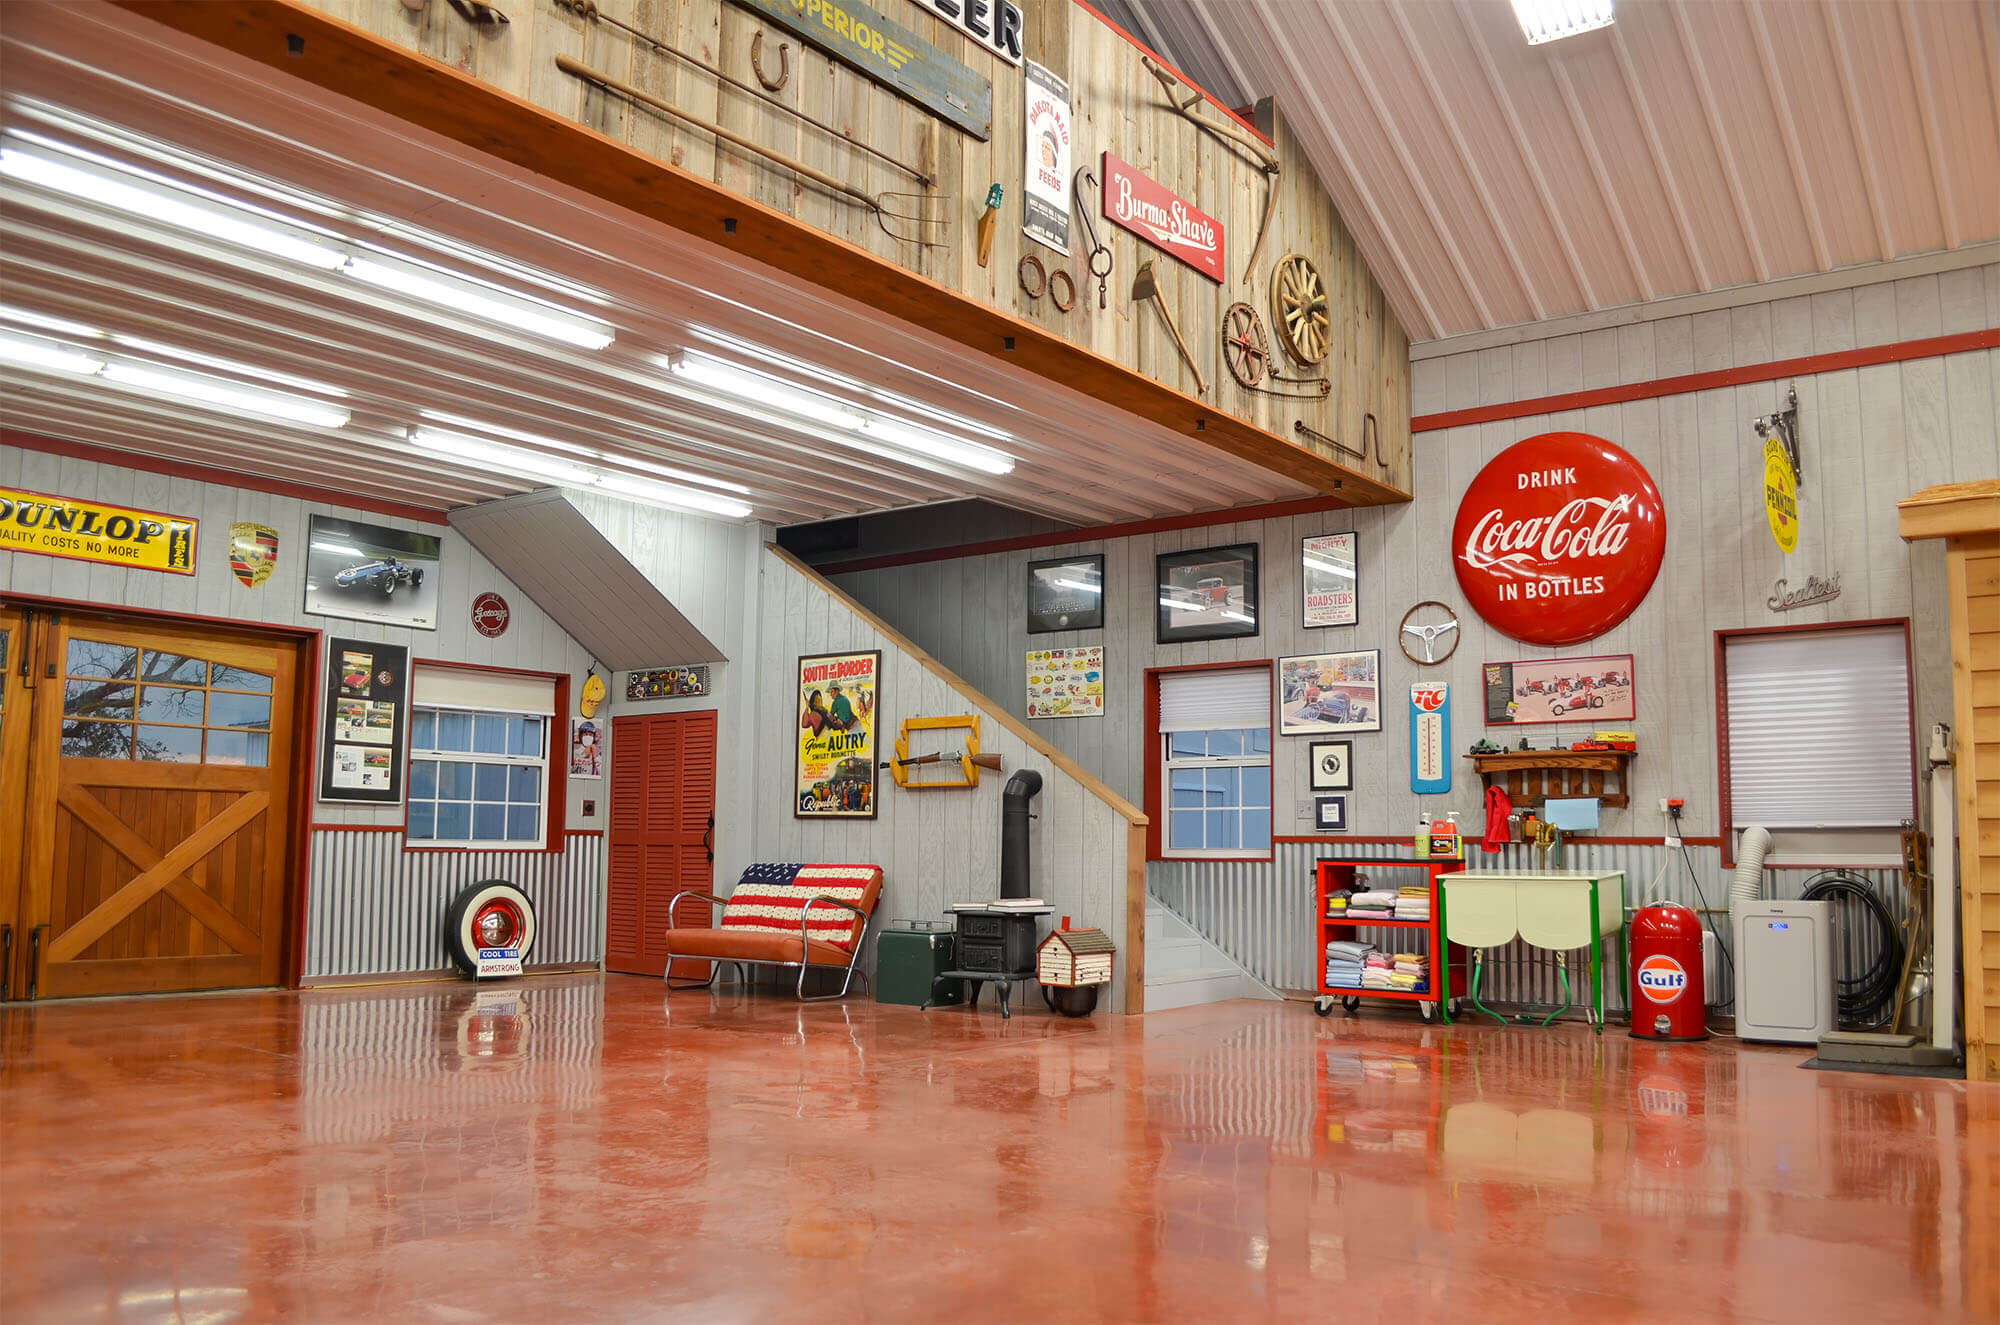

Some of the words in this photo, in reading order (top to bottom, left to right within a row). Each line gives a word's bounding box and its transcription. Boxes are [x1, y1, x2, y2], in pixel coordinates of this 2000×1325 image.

[1030, 100, 1054, 126] DAKOTA
[1054, 111, 1069, 146] MAID
[1038, 167, 1062, 193] FEEDS
[1114, 172, 1215, 248] Burma-Shave
[1518, 467, 1577, 490] DRINK
[1767, 484, 1798, 521] PENNZOIL
[1466, 493, 1638, 568] Coca-Cola
[0, 529, 36, 544] ALITY
[43, 534, 80, 550] COSTS
[86, 542, 102, 553] NO
[108, 545, 140, 558] MORE
[1307, 592, 1353, 608] ROADSTERS
[1499, 583, 1518, 601] IN
[1526, 576, 1604, 599] BOTTLES
[803, 664, 829, 684] SOUTH
[837, 658, 873, 678] BORDER
[1413, 690, 1446, 711] RC
[828, 732, 866, 751] AUTRY
[482, 964, 519, 972] ARMSTRONG
[1640, 971, 1683, 986] Gulf
